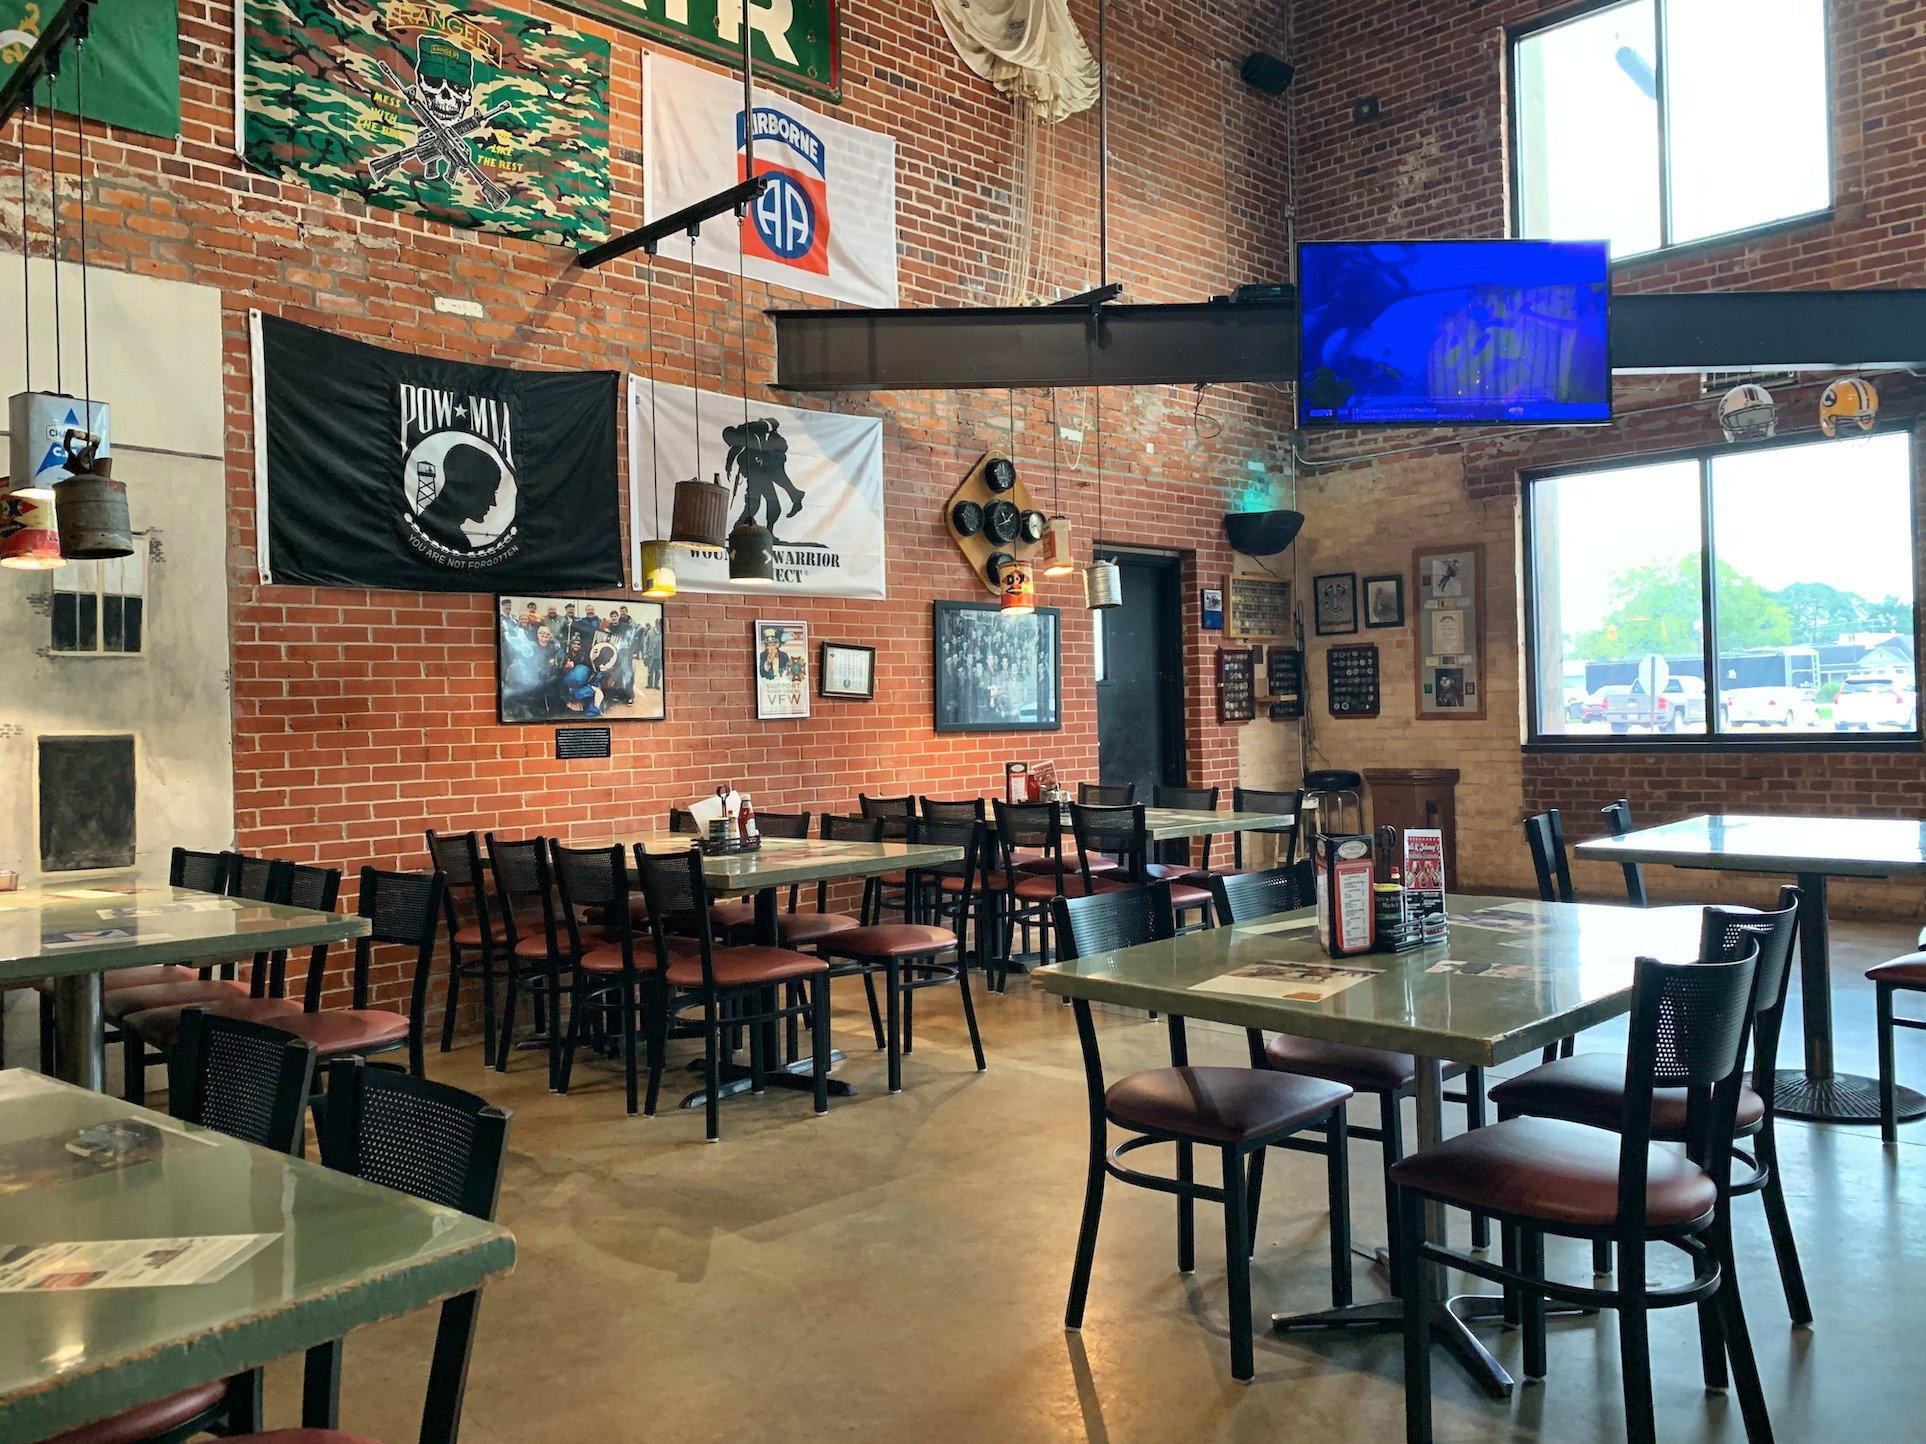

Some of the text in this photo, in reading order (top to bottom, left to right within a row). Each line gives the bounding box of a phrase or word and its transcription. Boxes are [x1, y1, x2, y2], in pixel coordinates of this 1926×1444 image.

[397, 7, 494, 58] RANGER
[373, 91, 400, 108] MESS
[370, 106, 398, 122] WITH
[477, 154, 524, 172] THE REST
[757, 178, 809, 251] AA
[400, 383, 516, 472] POW MIA
[408, 533, 519, 570] YOU ARE NOT FORGOTTEN
[773, 550, 841, 568] WARRIOR
[766, 682, 801, 690] SUPPORT
[767, 693, 802, 706] VFW
